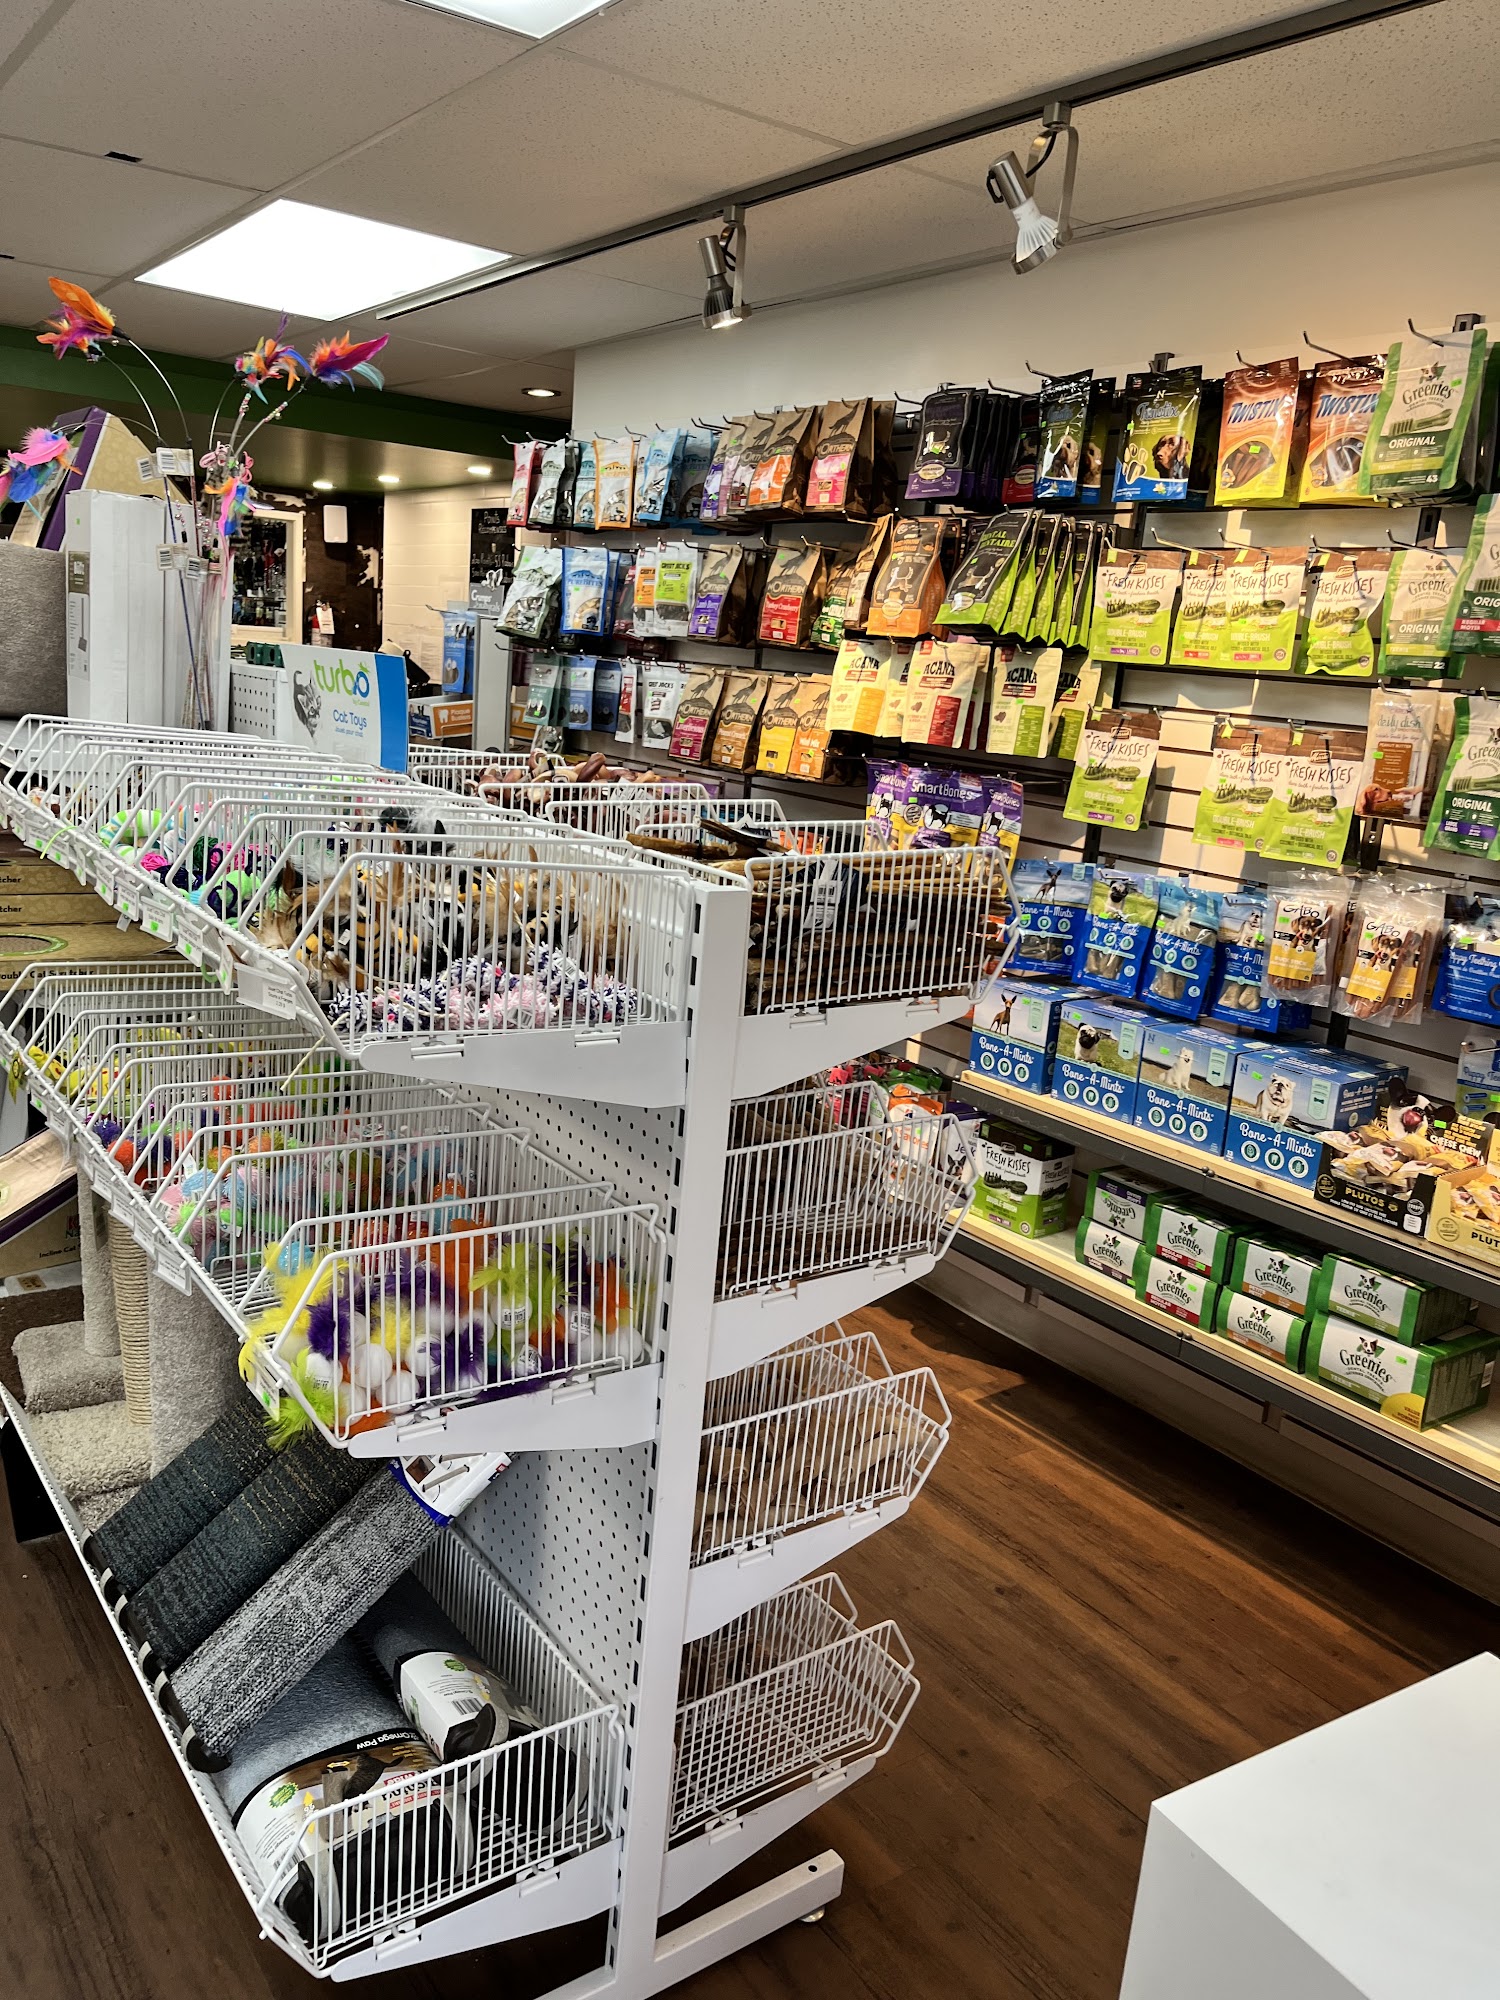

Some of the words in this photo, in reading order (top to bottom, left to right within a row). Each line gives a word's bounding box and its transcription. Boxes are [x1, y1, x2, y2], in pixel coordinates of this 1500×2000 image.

[1402, 381, 1455, 406] Greenies
[1136, 400, 1180, 420] Twistix
[1227, 395, 1286, 425] TWISTIX
[816, 442, 855, 457] NORTHERN
[1388, 436, 1436, 450] ORIGINAL
[767, 581, 805, 593] NORTHERN
[1107, 573, 1132, 590] FRESH
[1135, 575, 1166, 590] KISSES
[1190, 573, 1214, 591] FRESH
[1233, 573, 1257, 590] FRESH
[1258, 573, 1291, 589] KISSES
[1316, 579, 1340, 596] FRESH
[1342, 577, 1375, 596] KISSES
[1408, 578, 1454, 596] Greenies
[1473, 596, 1500, 609] ORIG
[1398, 623, 1440, 634] ORIGINA
[849, 656, 880, 670] ACANA
[923, 660, 956, 676] ACANA
[1433, 661, 1446, 670] 22
[313, 659, 371, 699] turbo
[1004, 667, 1038, 684] ACANA
[333, 708, 348, 723] Cat
[349, 710, 368, 728] Toys
[679, 704, 711, 717] NORTHERN
[721, 710, 754, 722] NORTHERN
[762, 714, 797, 727] NORTHERN
[800, 717, 826, 729] NORTHE
[1089, 736, 1116, 756] FRESH
[1118, 743, 1150, 758] KISSES
[1468, 745, 1500, 761] Green
[1221, 754, 1245, 773] FRESH
[1247, 759, 1281, 777] KISSES
[1289, 762, 1317, 781] FRESH
[1318, 766, 1354, 784] KISSES
[873, 771, 906, 790] SmartBone
[911, 780, 973, 800] SmartBones
[1451, 797, 1493, 812] ORIGINAL
[1281, 825, 1326, 839] DOUBLE-BRUSH
[1018, 862, 1028, 871] N
[0, 876, 22, 884] tcher
[1163, 888, 1173, 898] N
[0, 905, 22, 913] tcher
[1018, 903, 1075, 918] Bone-A-Mints
[1282, 904, 1320, 919] GABO
[1091, 917, 1140, 937] Bone-A-Mints
[1366, 921, 1401, 938] GABO
[1154, 930, 1202, 956] Bone-A-Mints
[1225, 947, 1264, 966] Bone-A-Mi
[1, 972, 23, 980] oubl
[1063, 1011, 1070, 1020] N
[1148, 1033, 1155, 1043] N
[979, 1036, 1035, 1064] Bone-A-Mints
[1239, 1062, 1250, 1073] N
[1463, 1065, 1486, 1083] Puppy
[1062, 1063, 1125, 1094] Bone-A-Mints
[1147, 1089, 1214, 1122] Bone-A-Mints
[1239, 1122, 1316, 1158] Bone-A-Mints
[1429, 1134, 1458, 1150] CHEESE
[1458, 1144, 1482, 1158] CHEW
[985, 1146, 1007, 1168] FRESH
[1007, 1157, 1031, 1174] KISSES
[1344, 1187, 1385, 1207] PLUTOS
[1167, 1231, 1203, 1256] Greenies
[1471, 1231, 1500, 1249] PLUT
[1092, 1243, 1124, 1267] Greenies
[1254, 1268, 1296, 1295] Greenies
[1156, 1279, 1192, 1305] Greenies
[1344, 1285, 1388, 1313] Greenies
[1237, 1316, 1276, 1344] Greenies
[1339, 1349, 1393, 1385] Greenies
[1346, 1366, 1366, 1374] DENTAL
[356, 1737, 378, 1750] Paw
[377, 1732, 412, 1743] Omega
